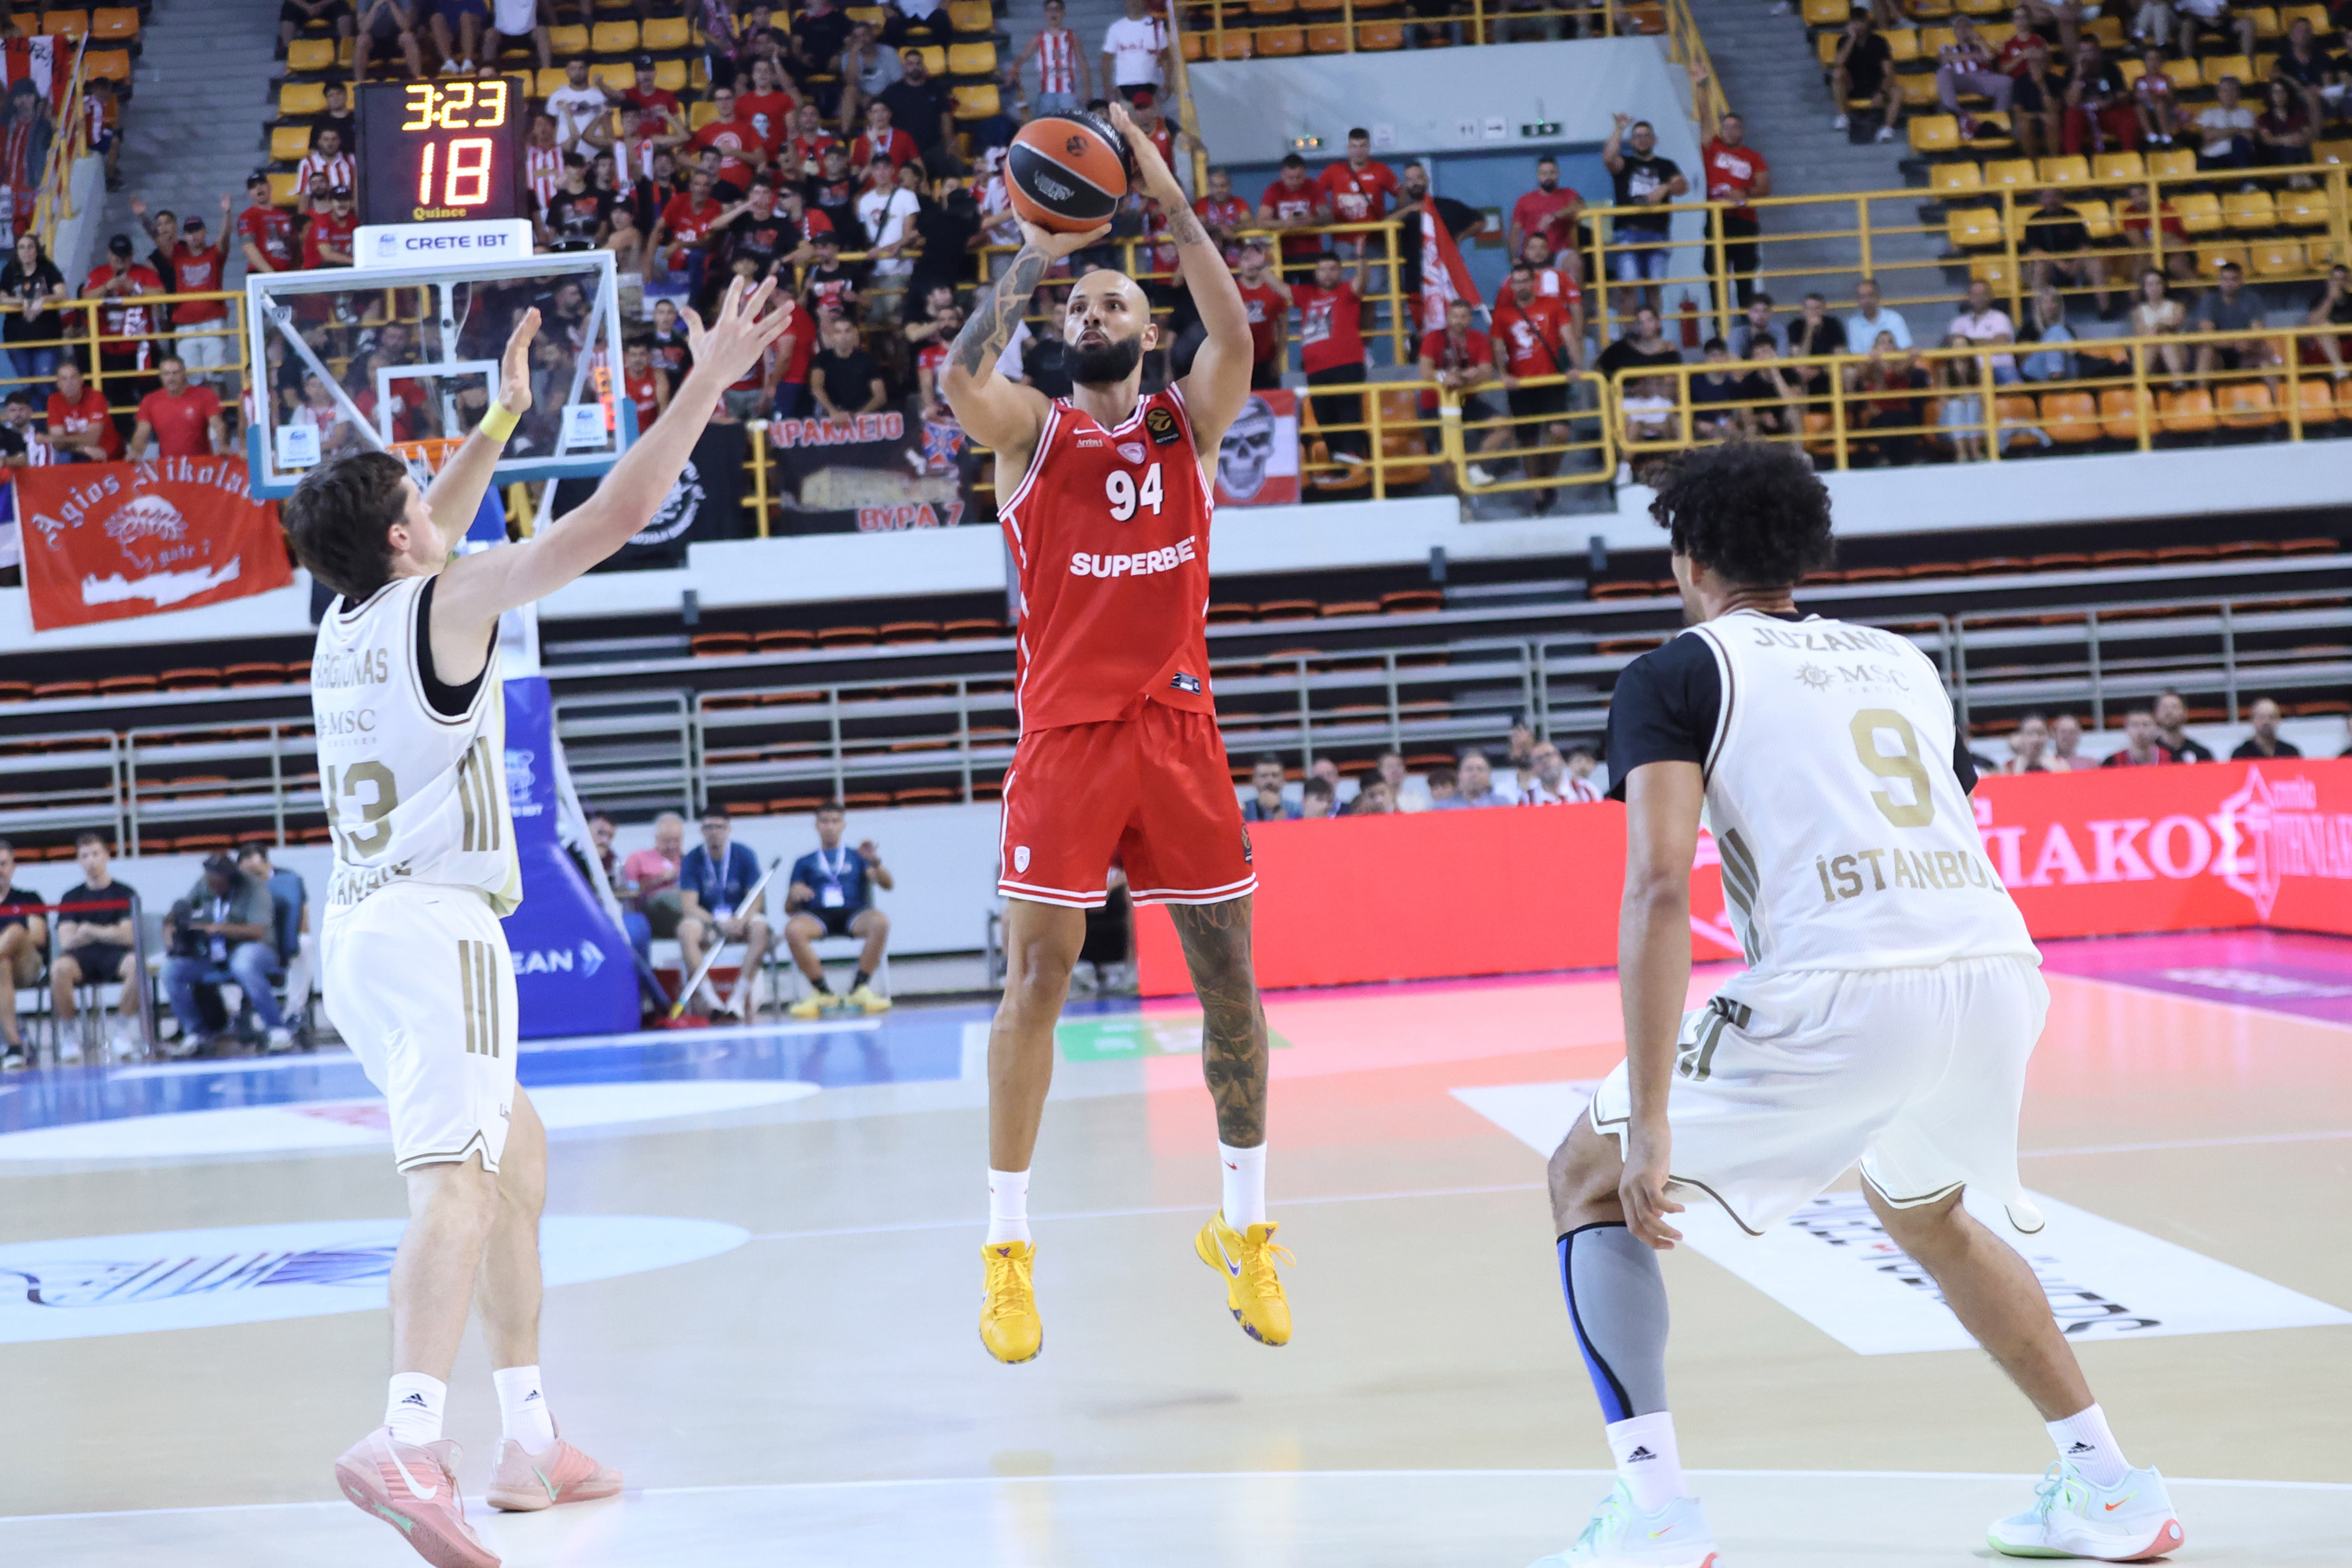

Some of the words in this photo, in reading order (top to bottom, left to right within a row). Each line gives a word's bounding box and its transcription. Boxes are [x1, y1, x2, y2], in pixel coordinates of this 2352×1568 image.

[402, 81, 507, 131] 3:23
[419, 138, 492, 206] 18
[413, 207, 467, 221] Quince
[406, 236, 471, 251] CRETE
[478, 234, 509, 247] IBT
[1106, 462, 1164, 522] 94
[31, 474, 121, 551] Agios
[945, 500, 964, 527] 7
[1069, 535, 1196, 578] SUPERBE
[1753, 627, 1901, 657] JUZANG
[1834, 664, 1911, 691] MSC
[329, 709, 376, 734] MSC
[1849, 709, 1935, 827] 9
[327, 760, 398, 865] 13
[511, 949, 573, 975] EAN
